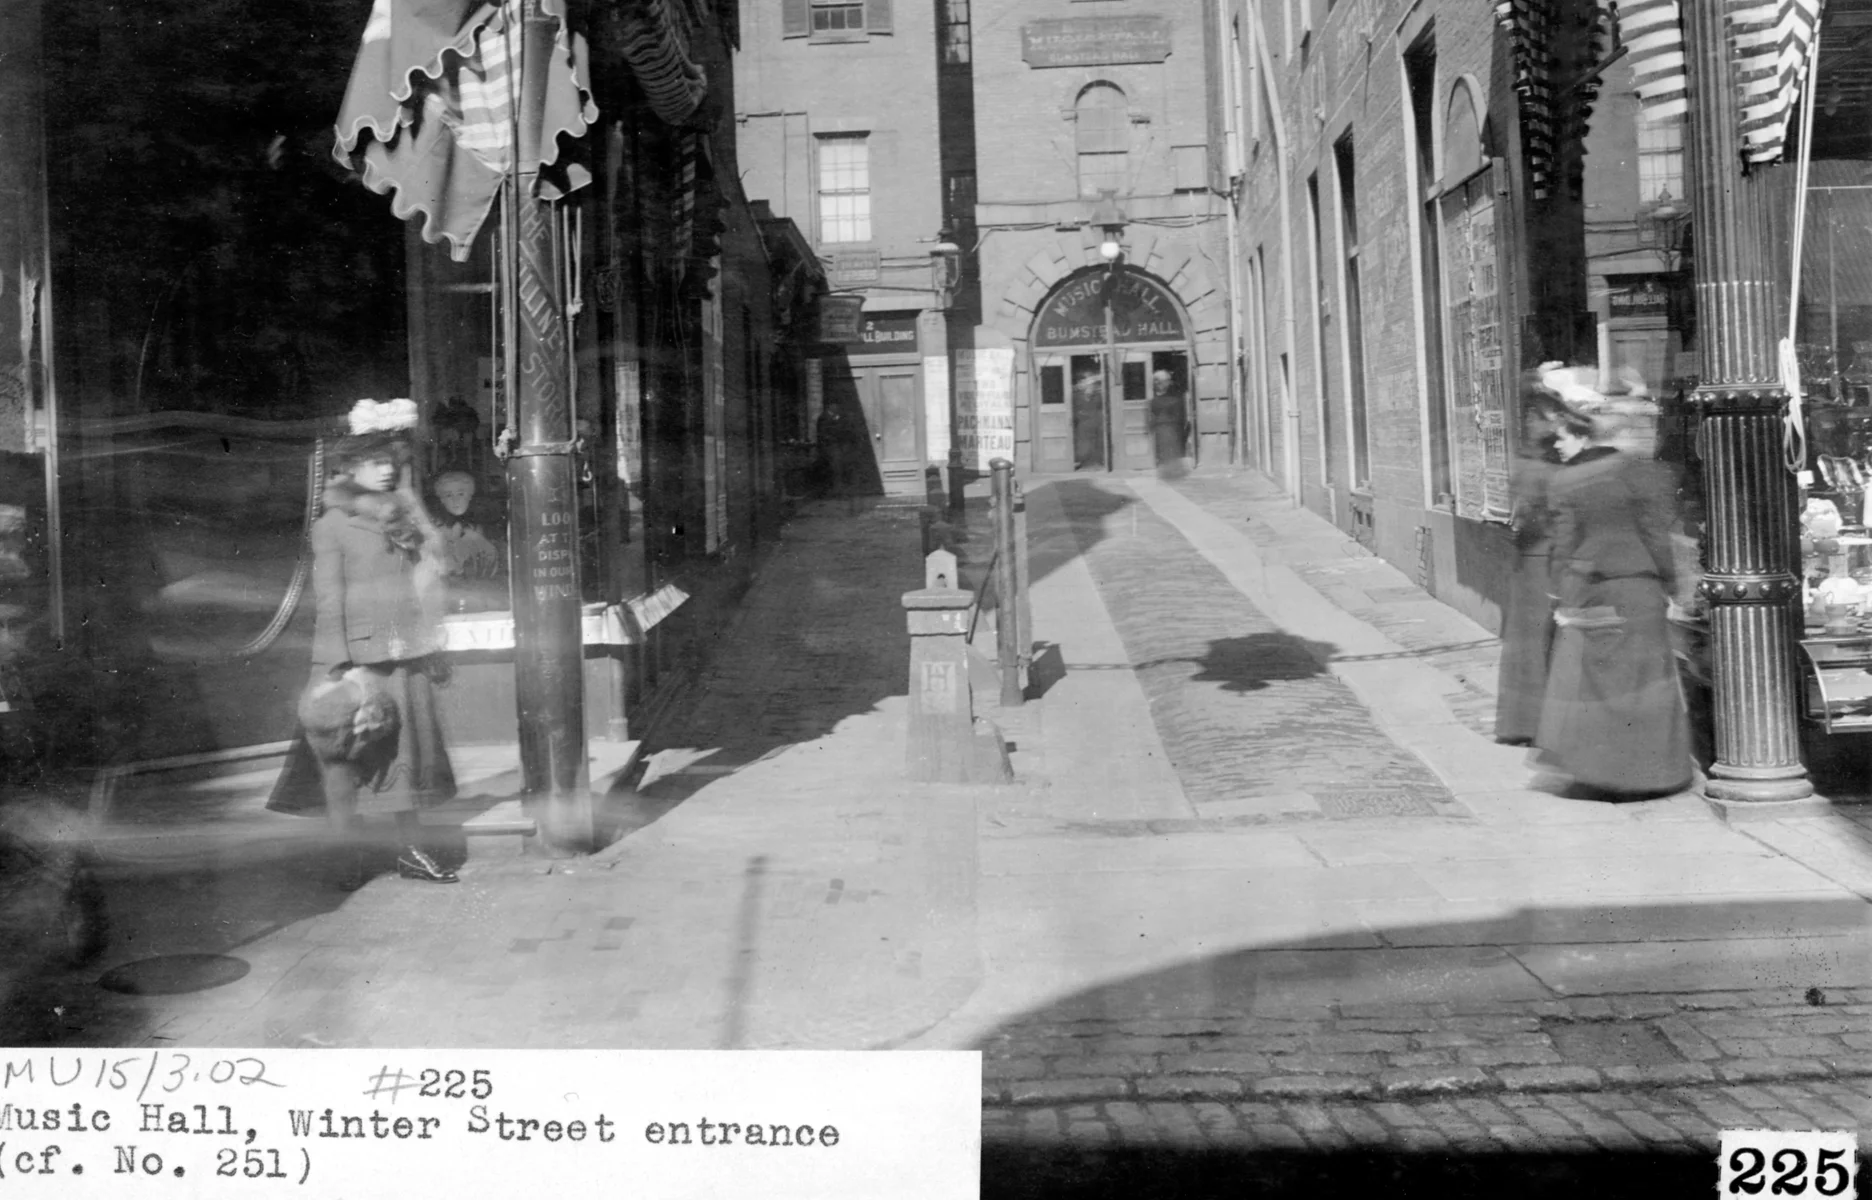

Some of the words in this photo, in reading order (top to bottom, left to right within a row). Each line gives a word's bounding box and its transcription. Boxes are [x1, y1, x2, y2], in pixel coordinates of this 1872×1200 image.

[1053, 279, 1102, 318] MUSIC
[865, 321, 875, 331] 2
[874, 330, 914, 343] BUILDING
[959, 435, 1012, 450] MARTEAU
[541, 511, 572, 526] LOO
[539, 533, 558, 544] AT
[533, 567, 546, 578] IN
